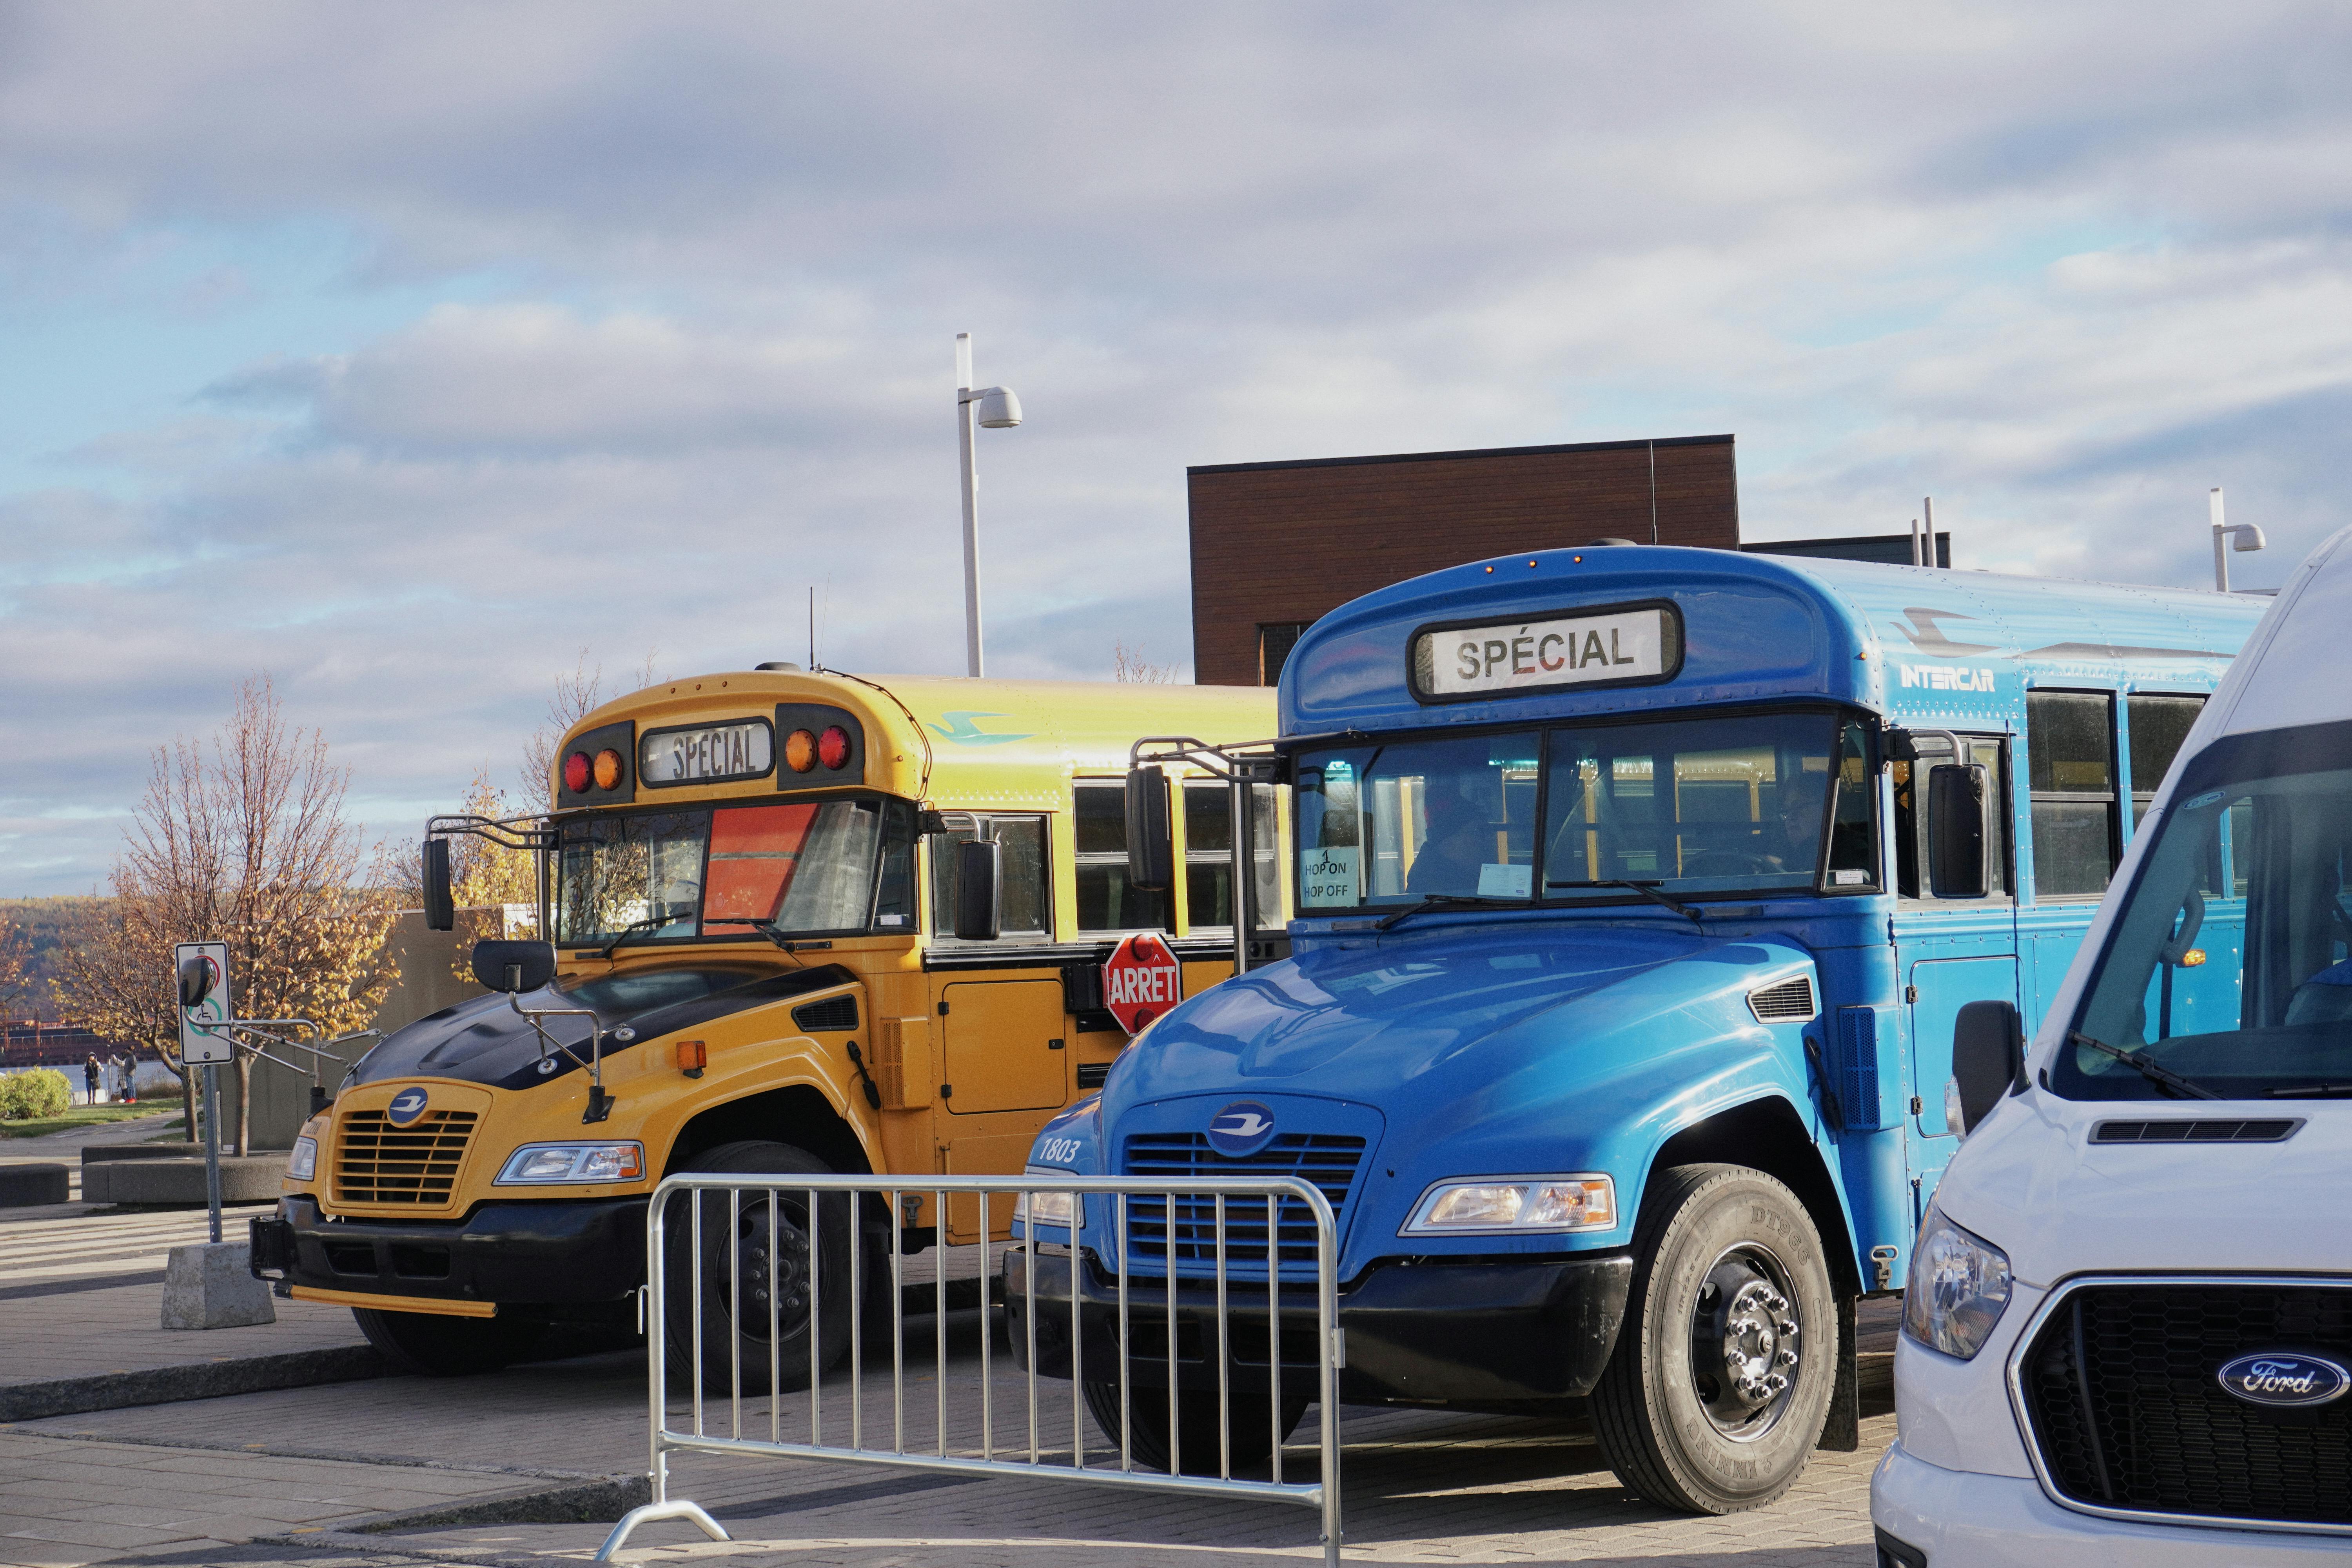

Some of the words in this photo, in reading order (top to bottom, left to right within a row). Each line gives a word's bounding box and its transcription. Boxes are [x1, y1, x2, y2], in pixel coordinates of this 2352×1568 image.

[1456, 626, 1635, 680] SPÉCIAL
[1901, 664, 1995, 692] INTERCAR
[673, 730, 756, 779] SPECIAL
[1305, 864, 1326, 876] HOP
[1329, 863, 1346, 874] ON
[1322, 849, 1330, 864] 1
[1304, 886, 1323, 897] HOP
[1327, 885, 1348, 897] OFF
[1110, 954, 1176, 1004] ARRÊT
[1040, 1138, 1081, 1163] 1803
[1751, 1206, 1810, 1266] DT966
[2243, 1361, 2315, 1393] Ford
